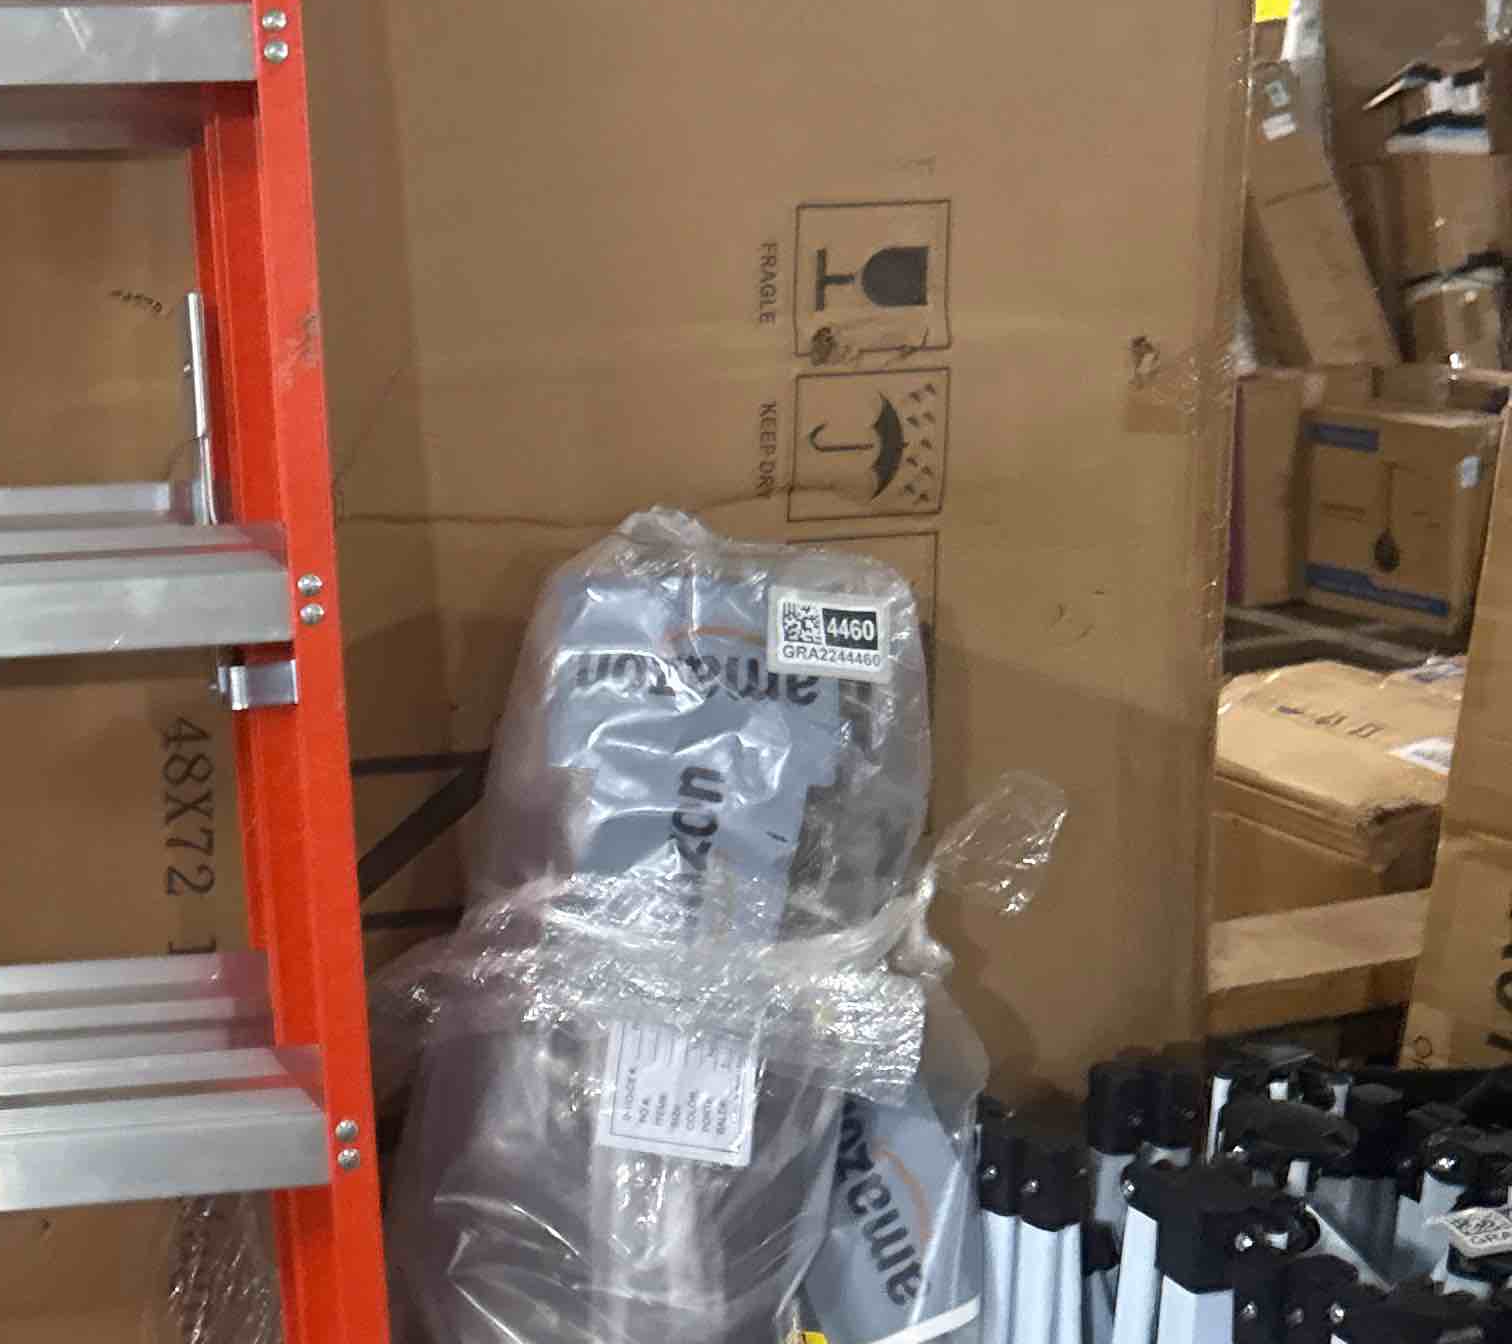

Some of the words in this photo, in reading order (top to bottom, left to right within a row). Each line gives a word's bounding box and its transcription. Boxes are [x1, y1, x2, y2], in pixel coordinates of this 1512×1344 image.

[758, 401, 777, 457] KEEP
[825, 615, 876, 642] 4460
[782, 644, 881, 667] GRA2244460
[163, 717, 215, 895] 48X72
